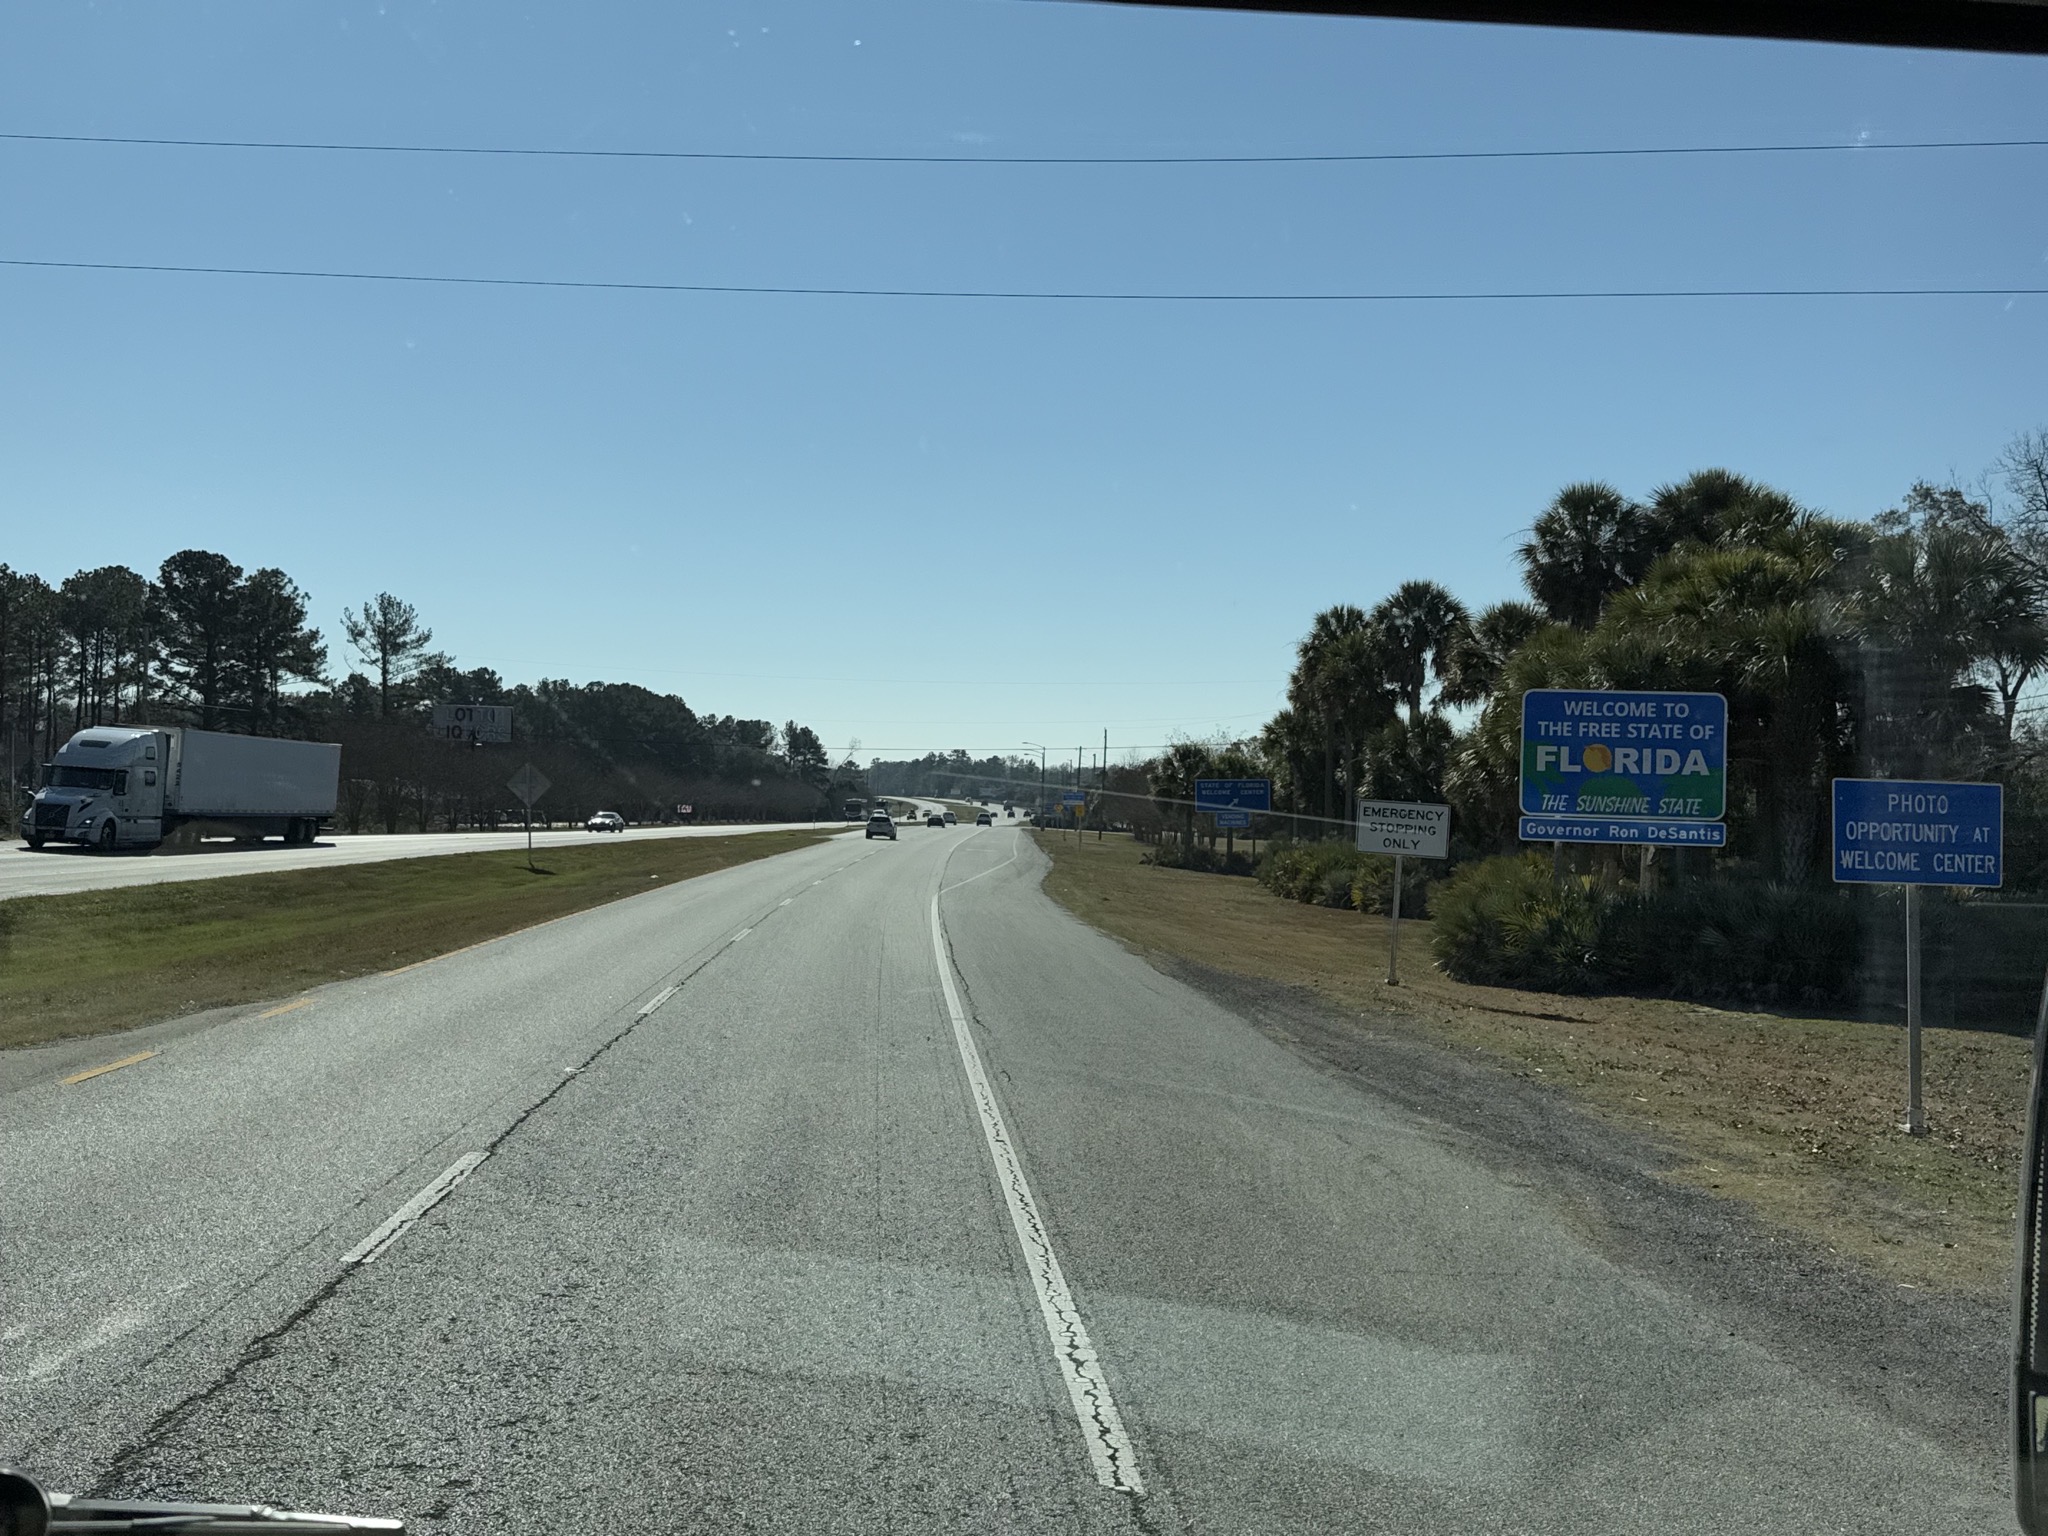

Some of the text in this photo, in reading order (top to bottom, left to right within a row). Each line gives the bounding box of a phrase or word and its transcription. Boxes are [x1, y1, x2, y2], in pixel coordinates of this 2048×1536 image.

[1564, 701, 1689, 718] WELCOME TO
[1537, 721, 1714, 740] THE FREE STATE OF
[1536, 743, 1710, 776] FLORIDA
[1363, 806, 1444, 821] EMERGENCY
[1541, 794, 1702, 815] THE SUNSHINE STATE
[1888, 794, 1948, 814] PHOTO
[1369, 822, 1436, 836] STOPPING
[1526, 822, 1721, 841] Governor Ron DeSantis
[1846, 821, 1990, 843] OPPORTUNITY AT
[1383, 838, 1420, 850] ONLY
[1840, 850, 1995, 873] WELCOME CENTER
